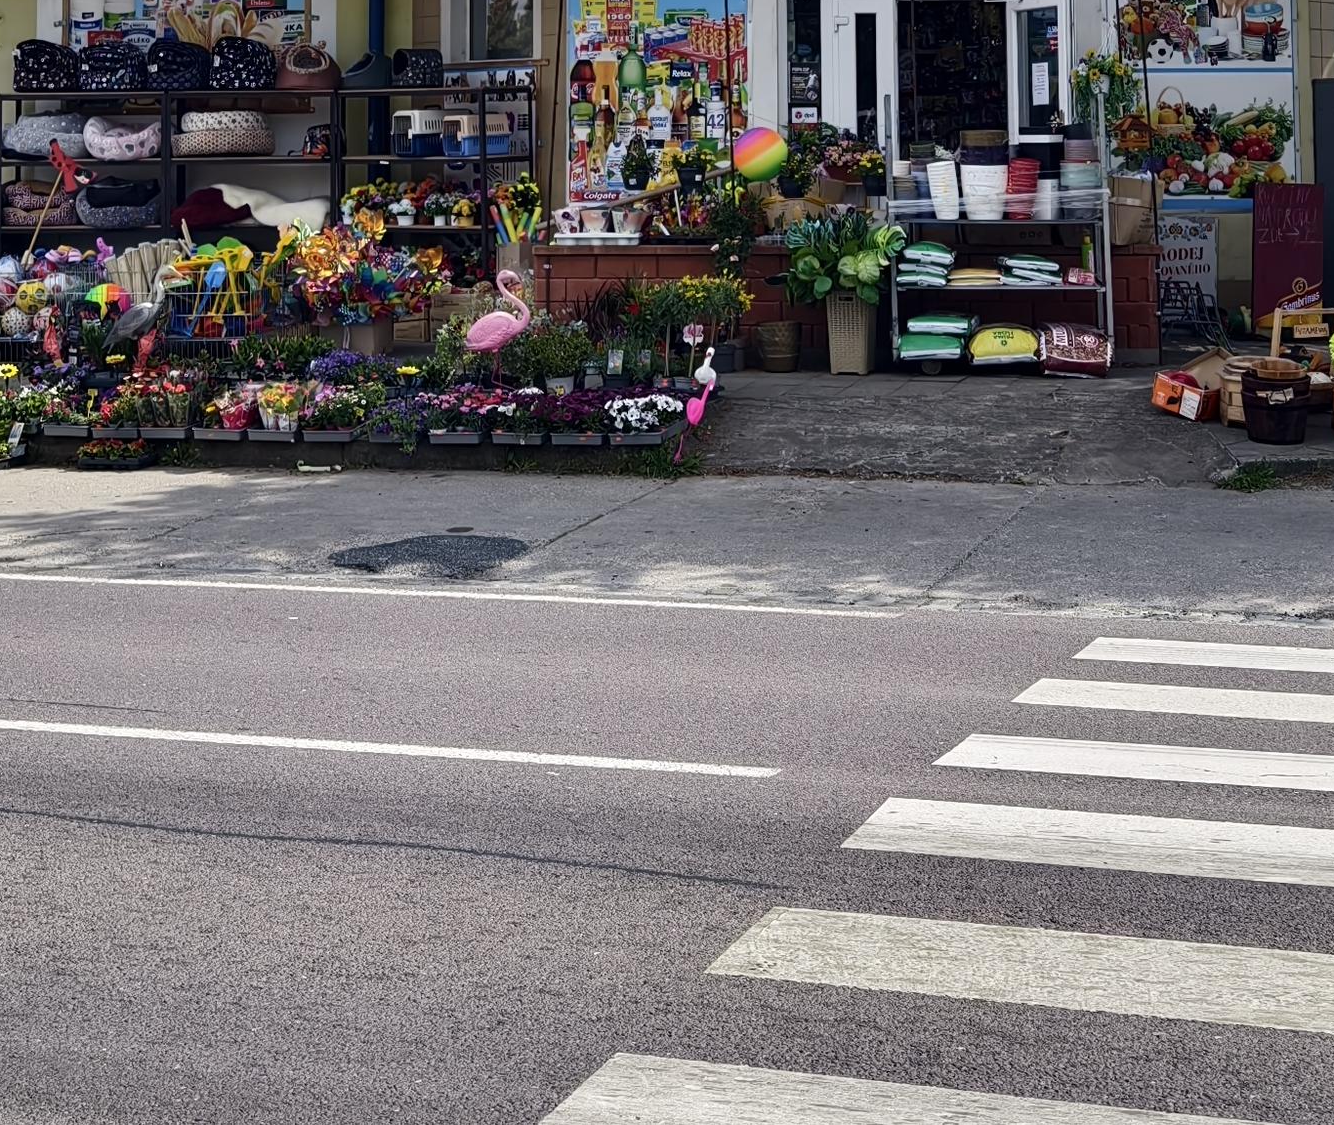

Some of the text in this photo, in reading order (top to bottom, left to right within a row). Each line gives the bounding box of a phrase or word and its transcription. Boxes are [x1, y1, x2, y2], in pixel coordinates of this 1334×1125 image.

[672, 69, 692, 78] Relax
[707, 114, 726, 129] 42
[583, 192, 618, 201] Colgate
[1161, 246, 1204, 262] ODEJ
